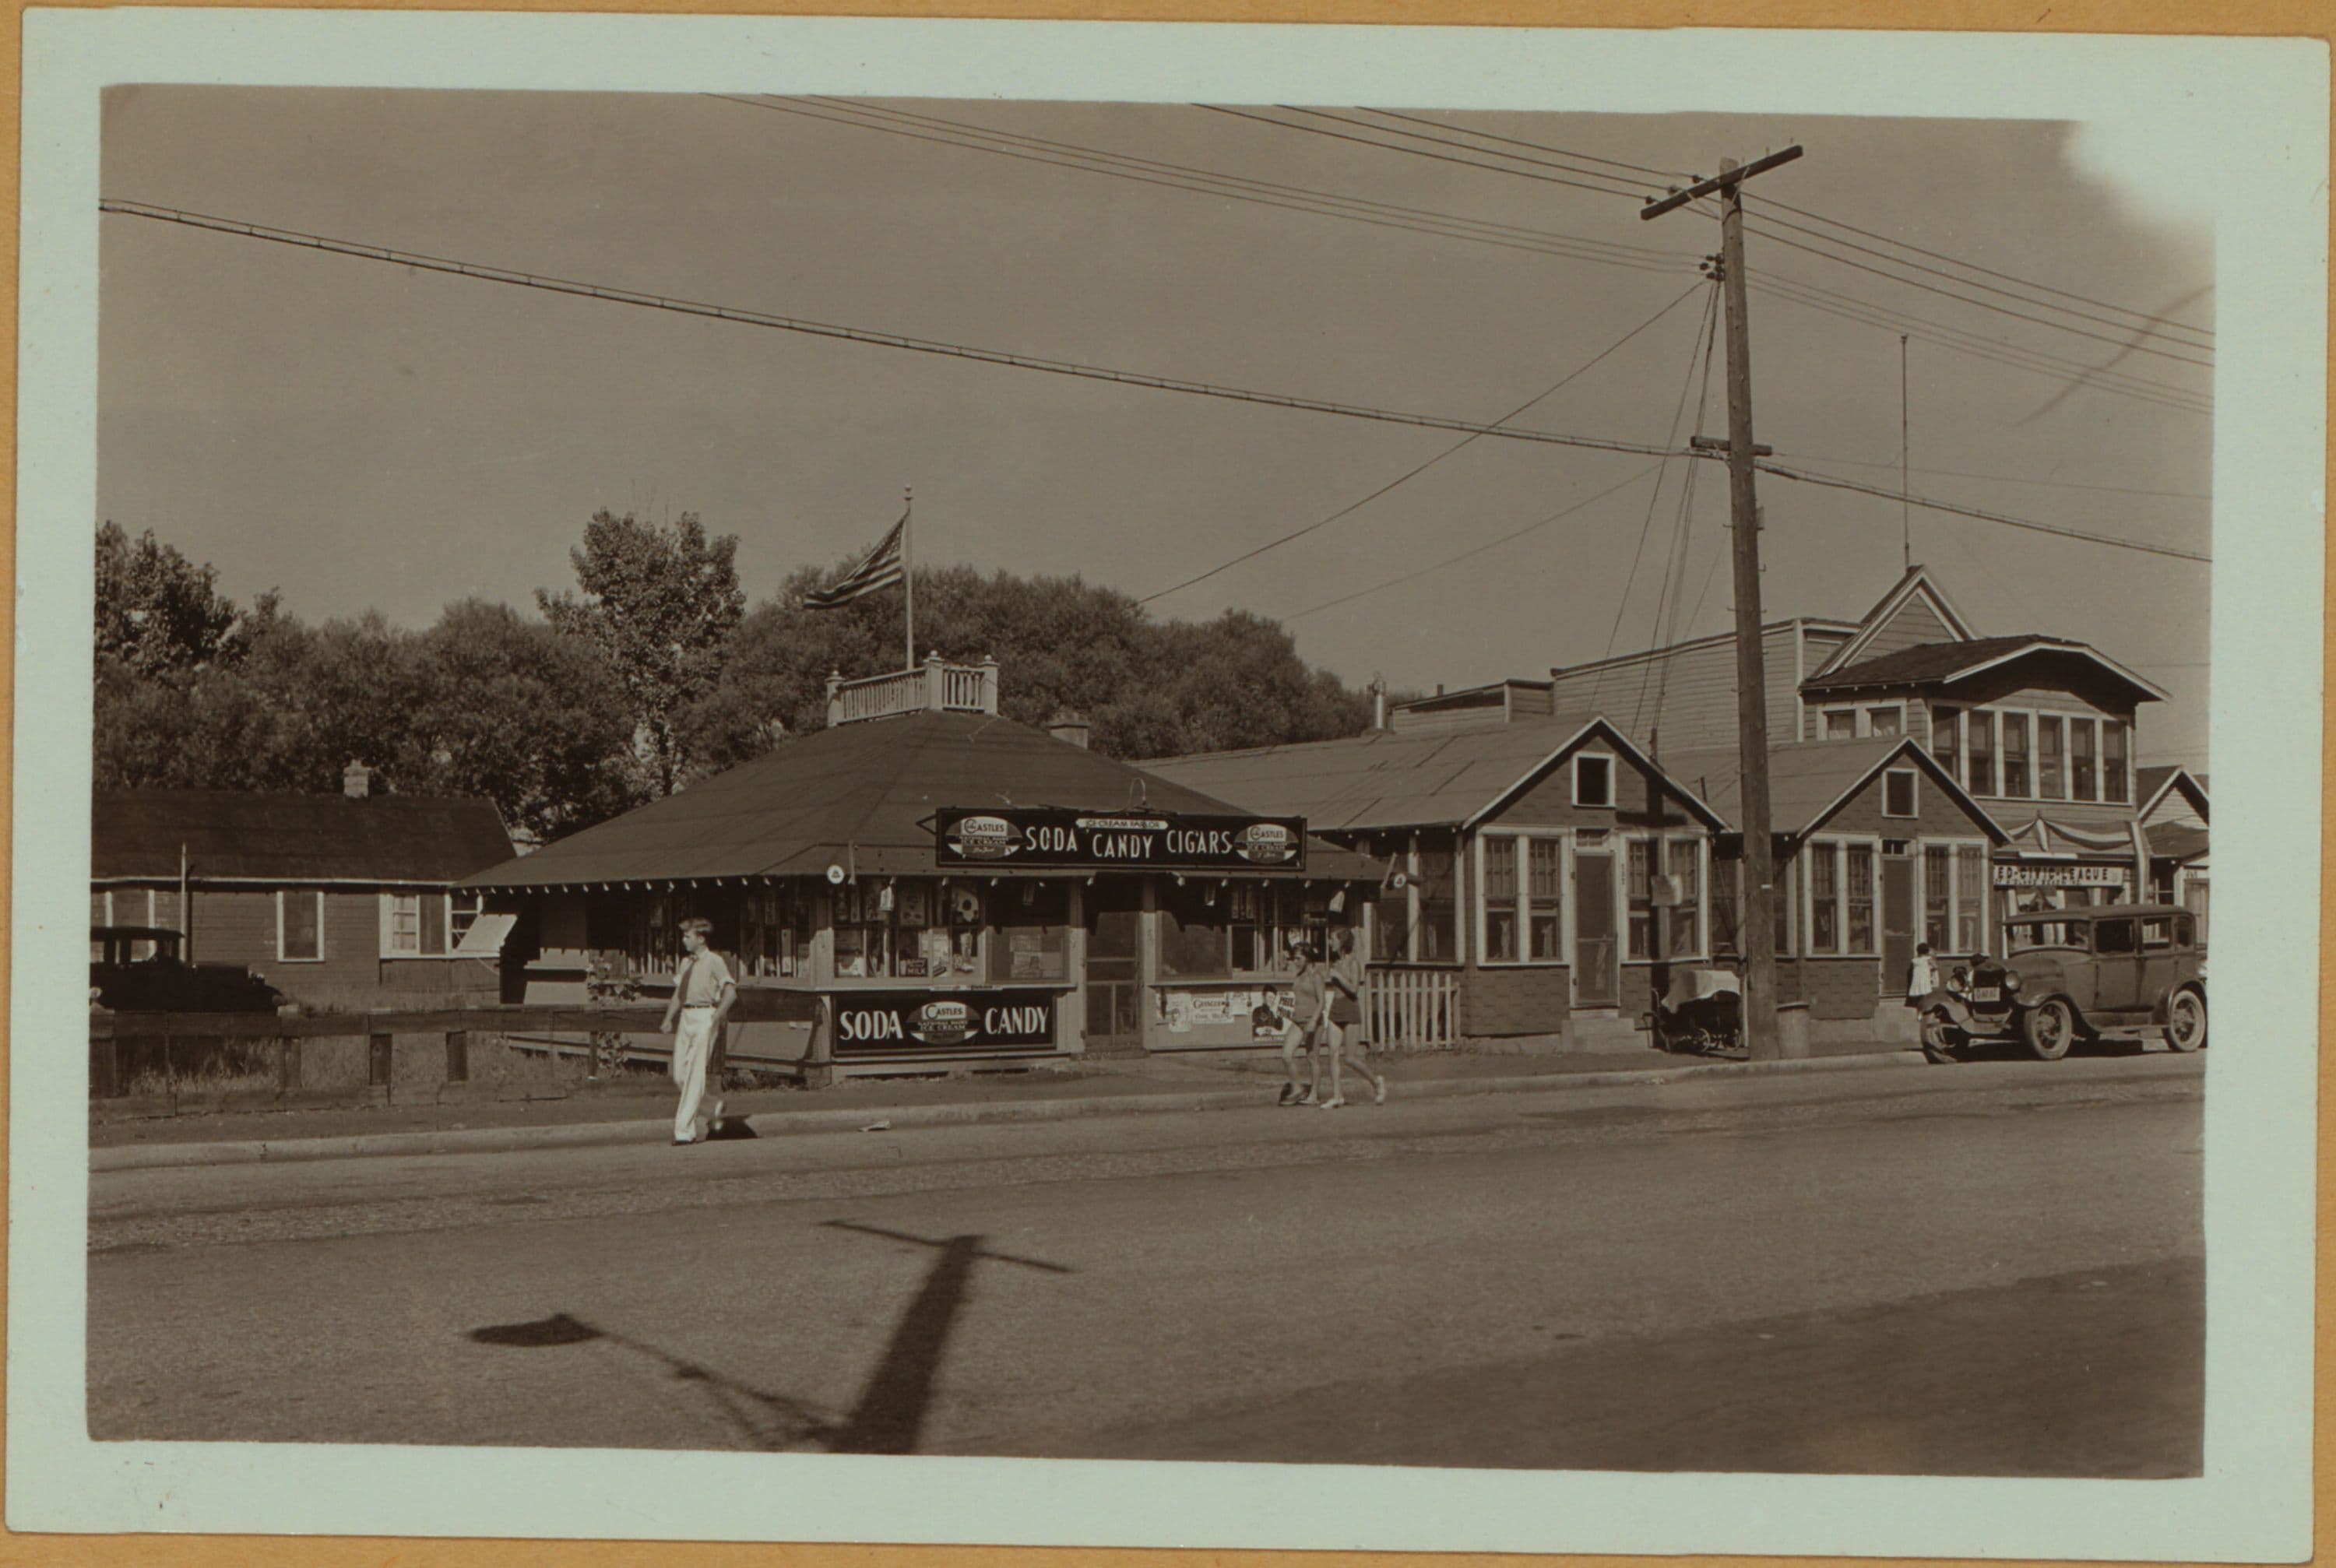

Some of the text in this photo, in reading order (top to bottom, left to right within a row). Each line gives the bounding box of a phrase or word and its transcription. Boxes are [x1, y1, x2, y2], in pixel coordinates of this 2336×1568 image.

[964, 818, 1005, 835] CASTLES
[1250, 825, 1284, 840] CASTLES
[1026, 826, 1230, 859] SODA CANDY CIGARS
[2061, 867, 2109, 881] LEAGUE
[926, 1004, 963, 1019] CASTLES
[984, 1006, 1050, 1034] CANDY
[839, 1011, 904, 1040] SODA
